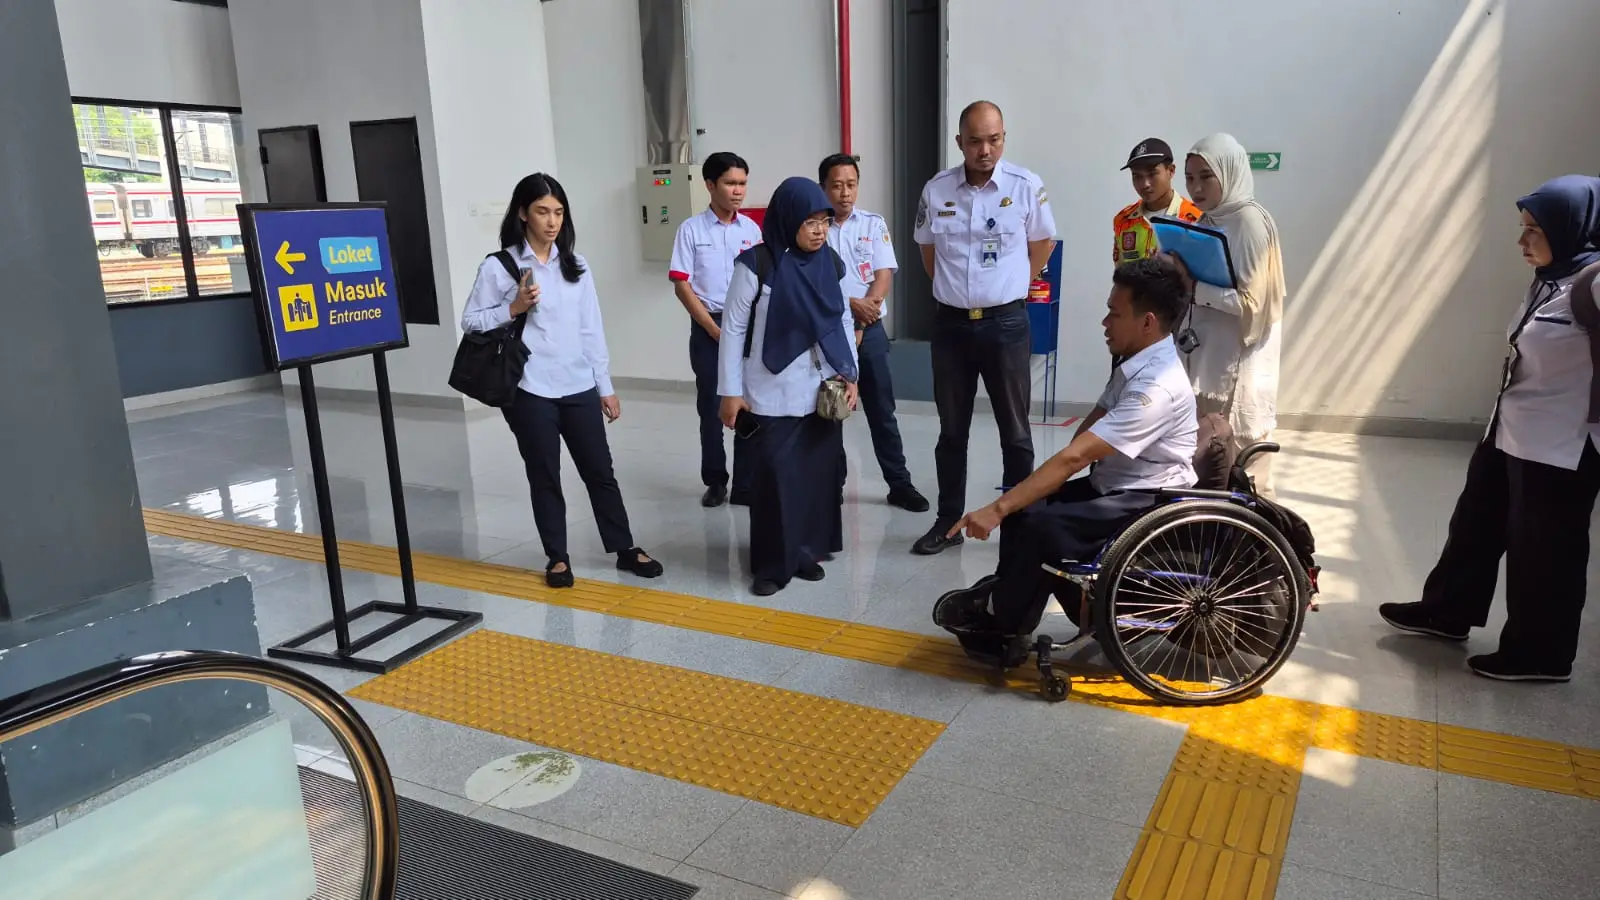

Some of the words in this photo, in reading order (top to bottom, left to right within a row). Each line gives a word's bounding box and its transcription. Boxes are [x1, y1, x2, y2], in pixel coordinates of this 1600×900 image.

[328, 244, 374, 265] Loket
[325, 276, 387, 303] Masuk
[329, 308, 382, 325] Entrance
